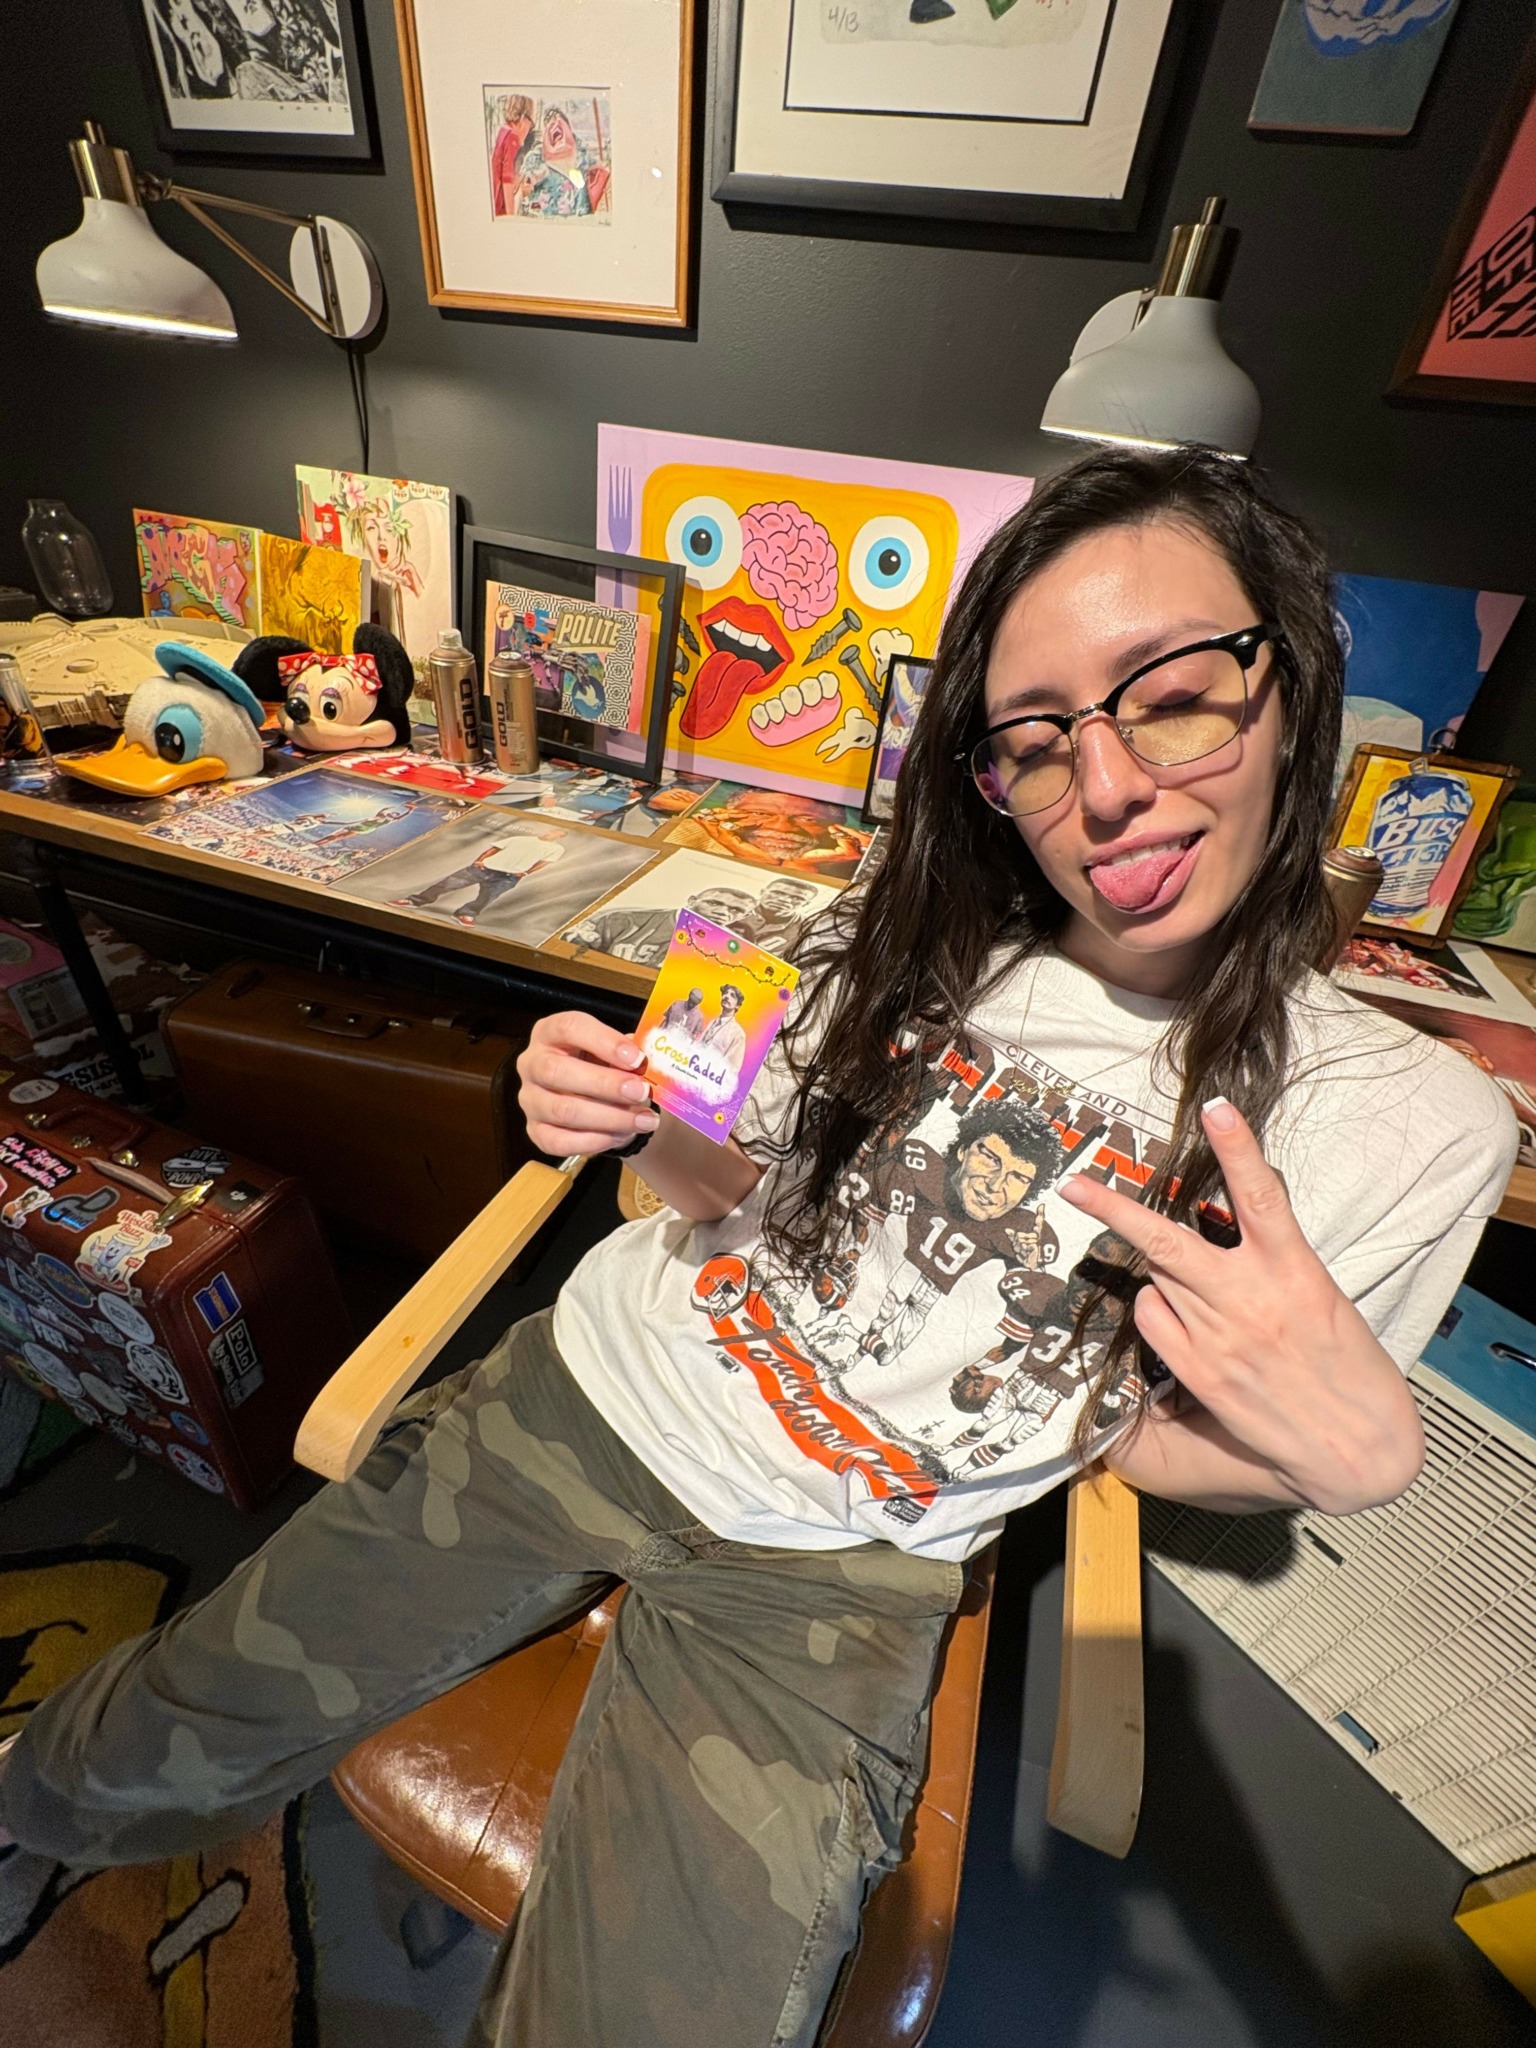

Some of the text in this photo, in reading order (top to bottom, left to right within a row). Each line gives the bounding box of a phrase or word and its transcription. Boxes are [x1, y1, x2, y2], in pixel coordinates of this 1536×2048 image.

[828, 5, 860, 33] 4/13
[523, 608, 622, 647] BE POLITE
[459, 678, 478, 749] GOLD
[496, 701, 508, 747] GOLD
[1004, 1044, 1128, 1118] CLEVELAND
[905, 1142, 926, 1172] 19
[917, 1215, 976, 1277] 19
[999, 1273, 1032, 1303] 34
[230, 1324, 250, 1368] Polo
[1029, 1325, 1098, 1382] 34
